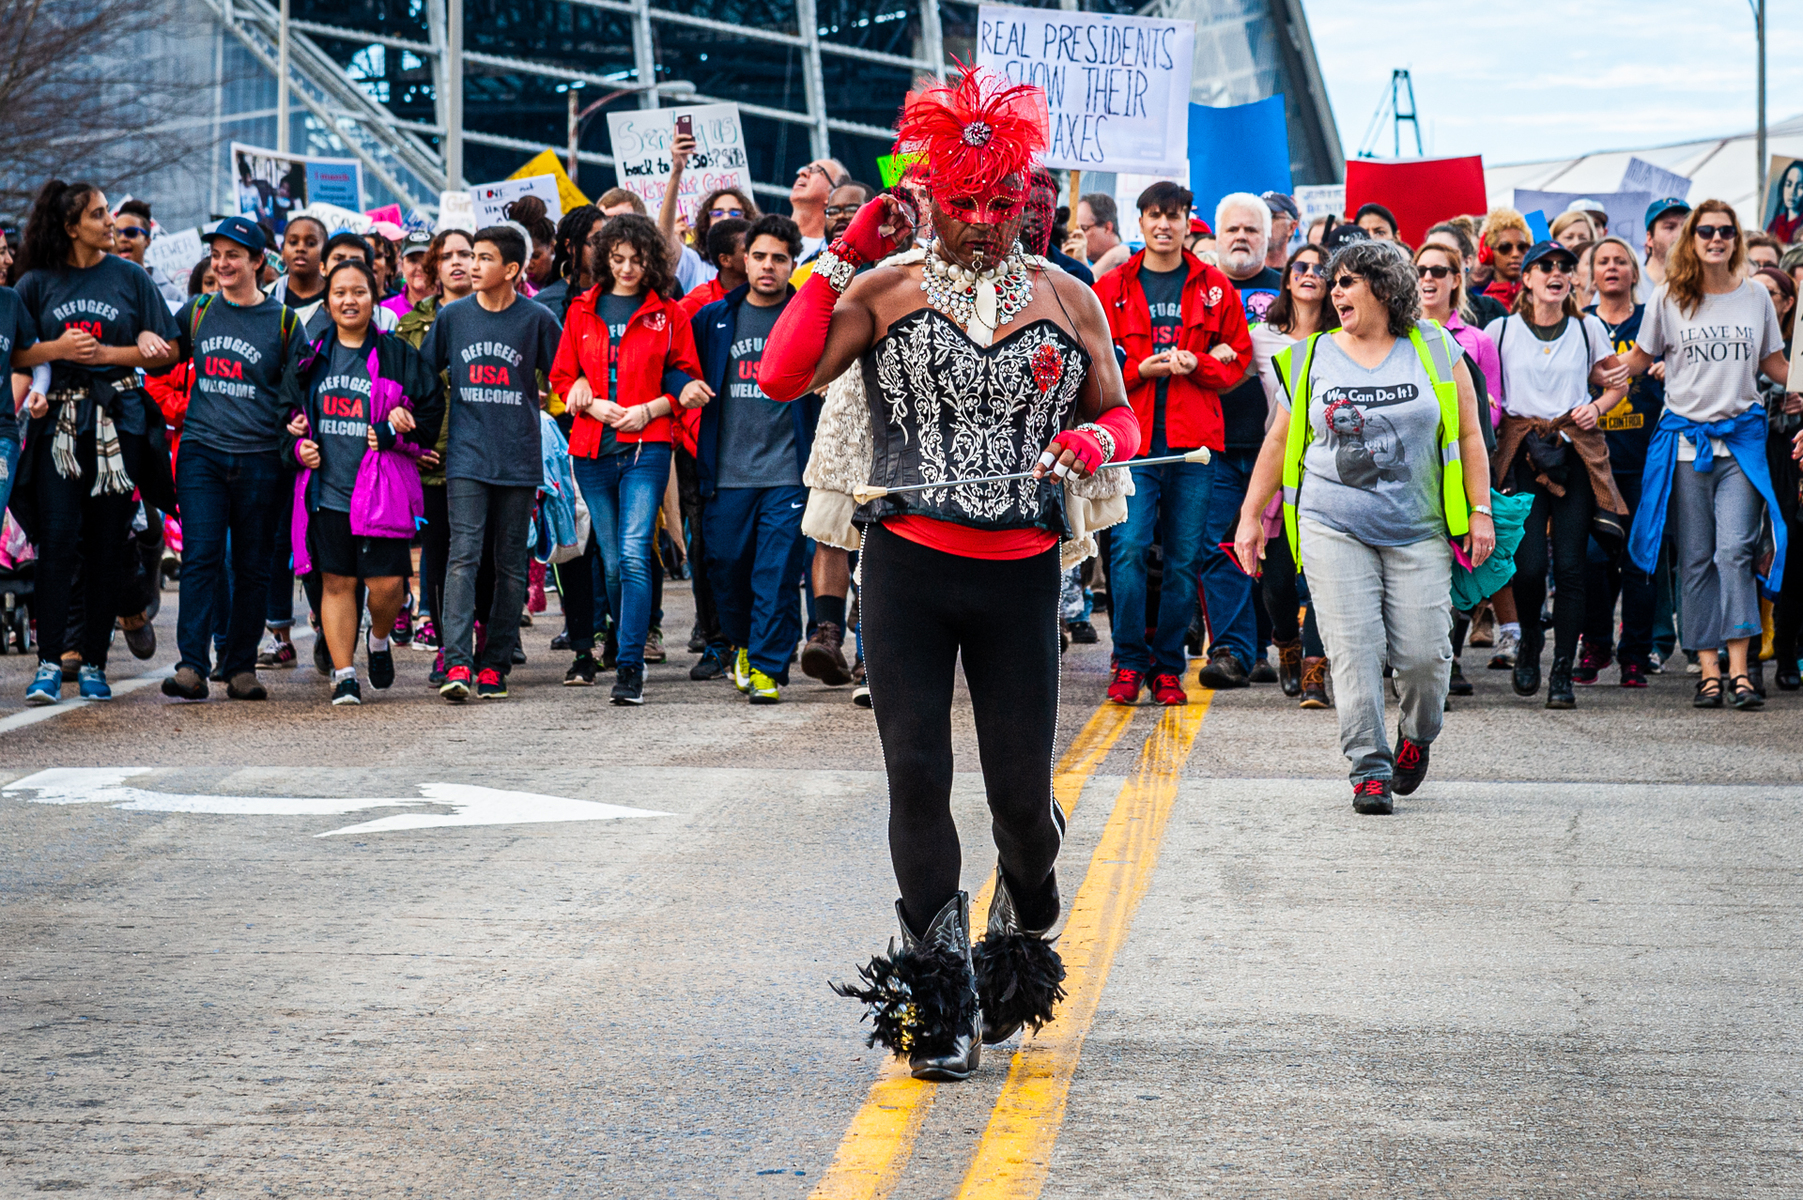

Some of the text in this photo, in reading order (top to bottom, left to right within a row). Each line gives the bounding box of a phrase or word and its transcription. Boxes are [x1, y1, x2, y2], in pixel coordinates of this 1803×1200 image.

[981, 20, 1176, 71] REAL PRESIDENTS
[1081, 66, 1149, 118] THEIR
[623, 157, 654, 177] back
[657, 157, 670, 174] to
[53, 299, 120, 322] REFUGEES
[1680, 325, 1755, 344] LEAVE ME
[201, 335, 262, 365] REFUGEES
[461, 341, 523, 367] REFUGEES
[205, 356, 243, 380] USA
[469, 364, 511, 386] USA
[460, 387, 523, 406] WELCOME
[1327, 384, 1414, 402] We Can Do It!
[323, 395, 364, 418] USA
[1608, 415, 1642, 429] CONTROL
